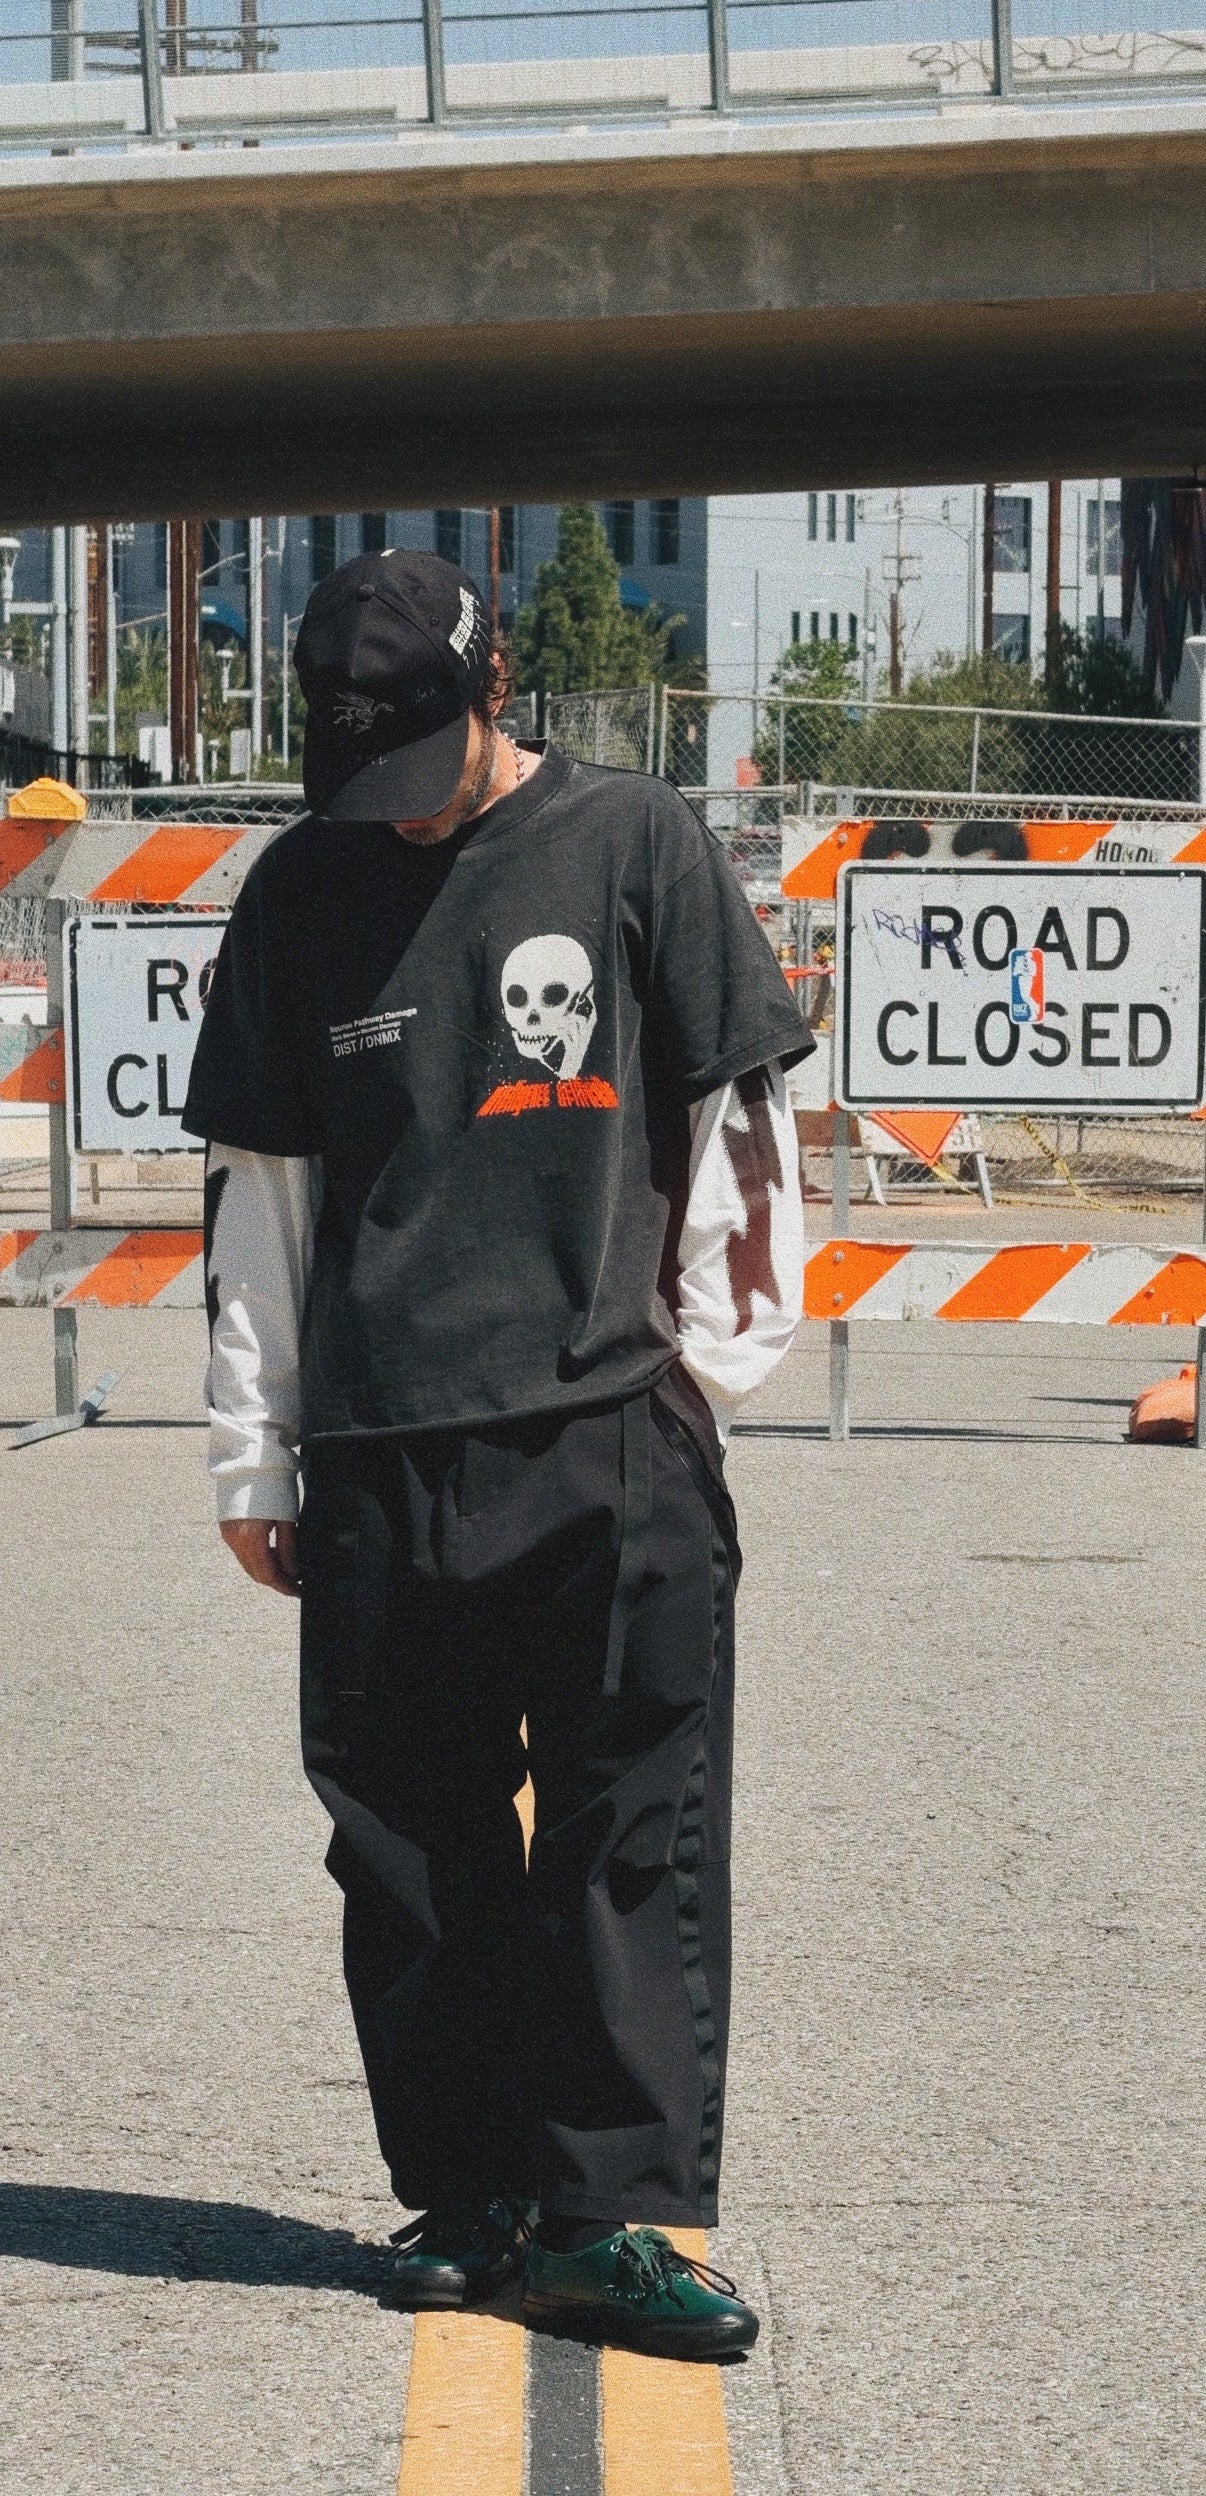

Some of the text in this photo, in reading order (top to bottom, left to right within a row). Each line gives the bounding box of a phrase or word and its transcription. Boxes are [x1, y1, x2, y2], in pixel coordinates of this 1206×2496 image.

[920, 905, 1130, 971] ROAD
[333, 1040, 357, 1058] DIST
[365, 1028, 402, 1049] DNMX
[877, 1001, 1172, 1067] CLOSED
